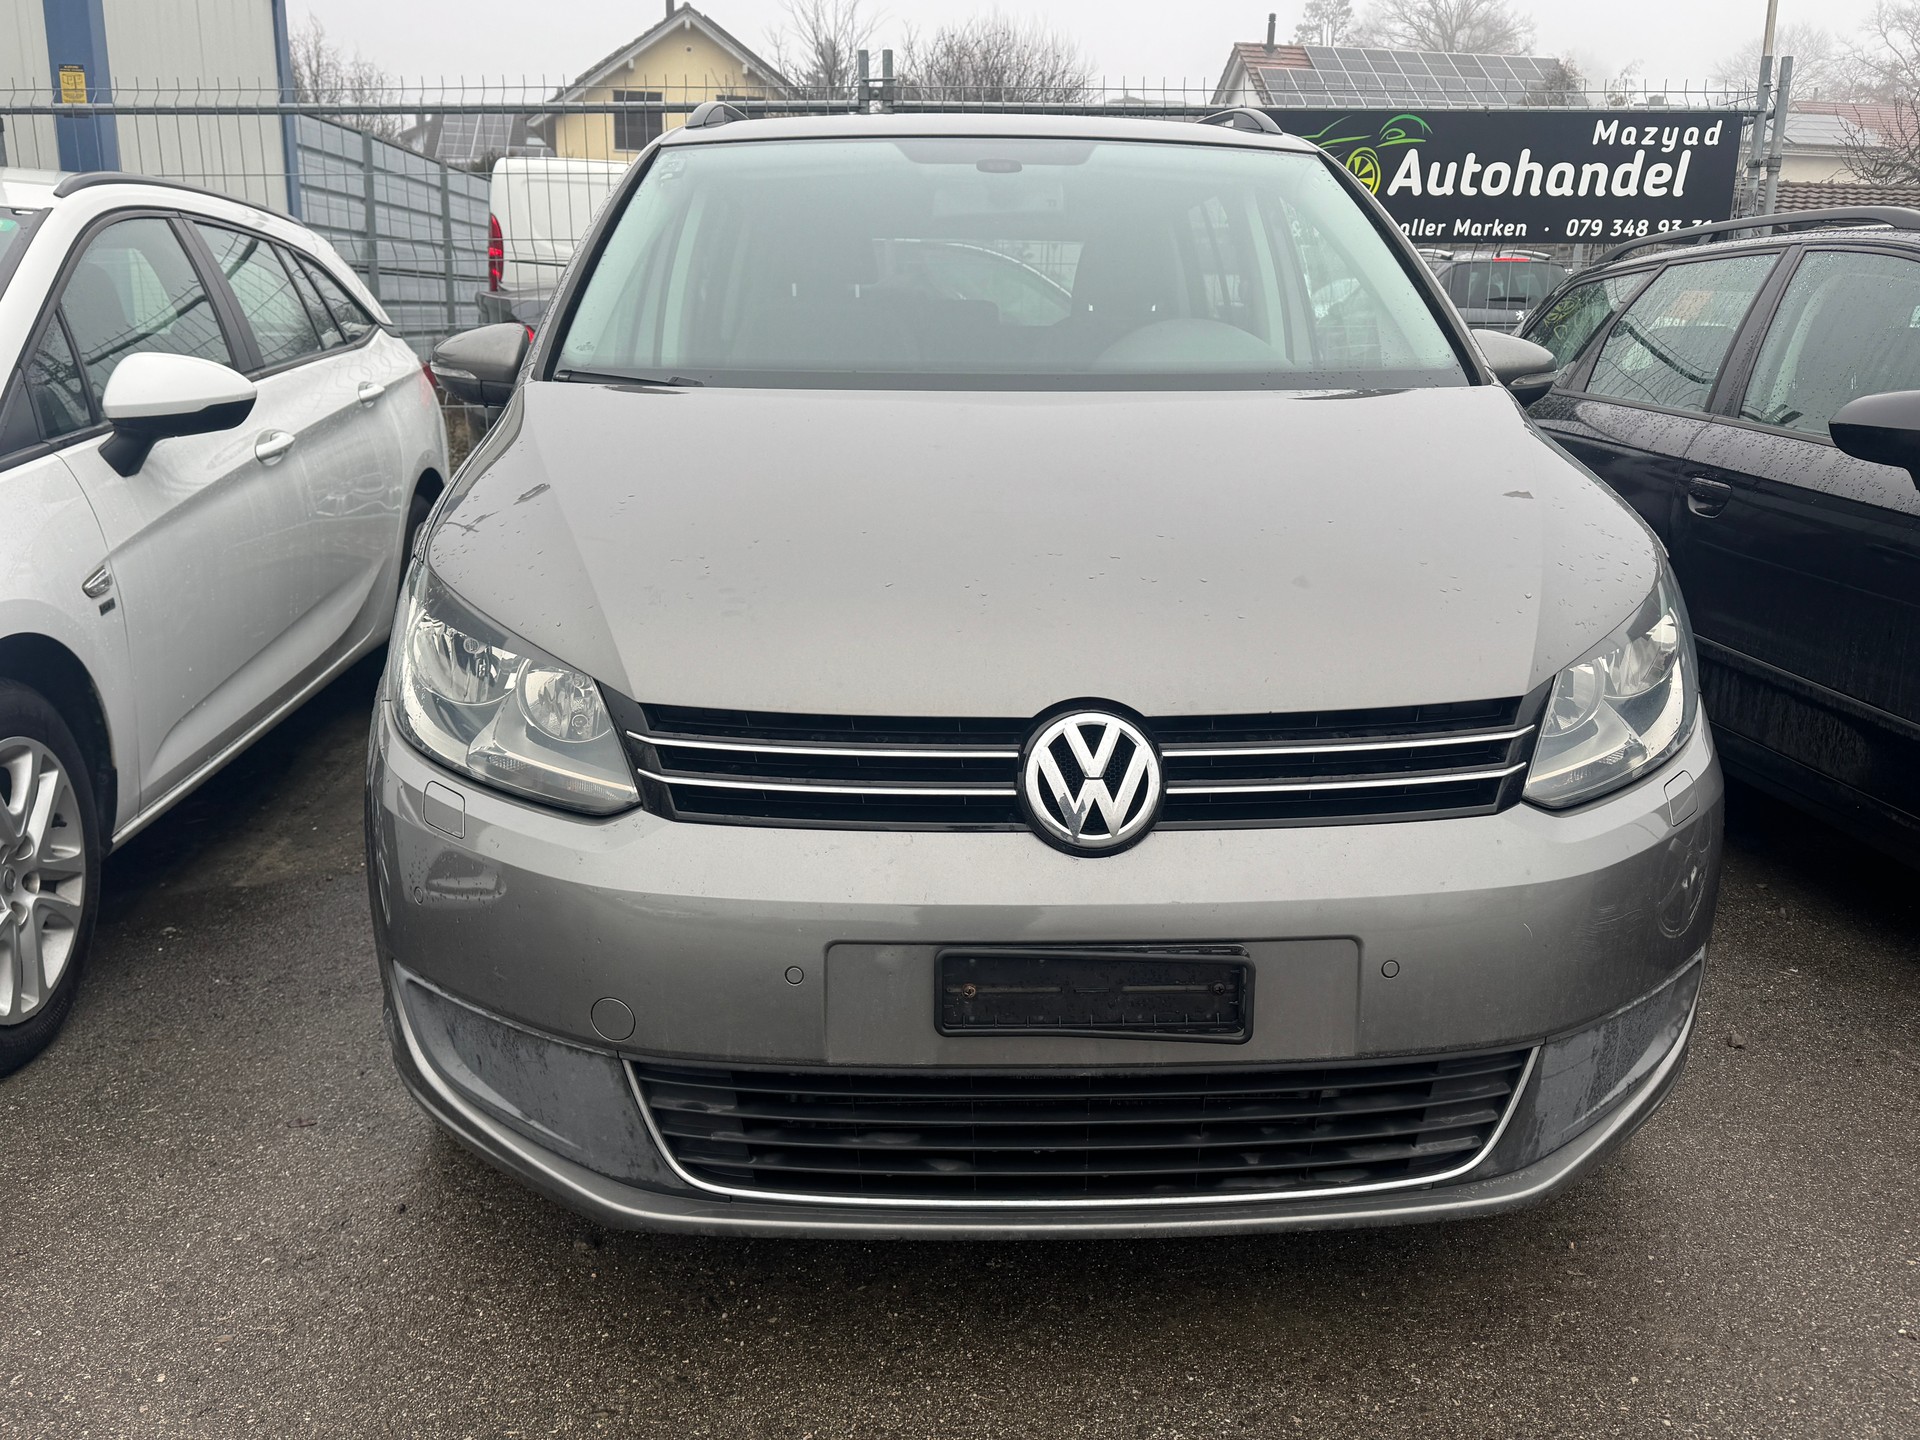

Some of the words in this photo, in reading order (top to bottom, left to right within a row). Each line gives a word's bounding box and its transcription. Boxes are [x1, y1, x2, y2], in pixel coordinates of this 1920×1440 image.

[1592, 119, 1723, 153] Mazyad
[1386, 148, 1692, 197] Autohandel
[1453, 218, 1527, 236] Marken
[1566, 218, 1603, 237] 079
[1610, 218, 1649, 237] 348
[1033, 719, 1153, 841] VW
